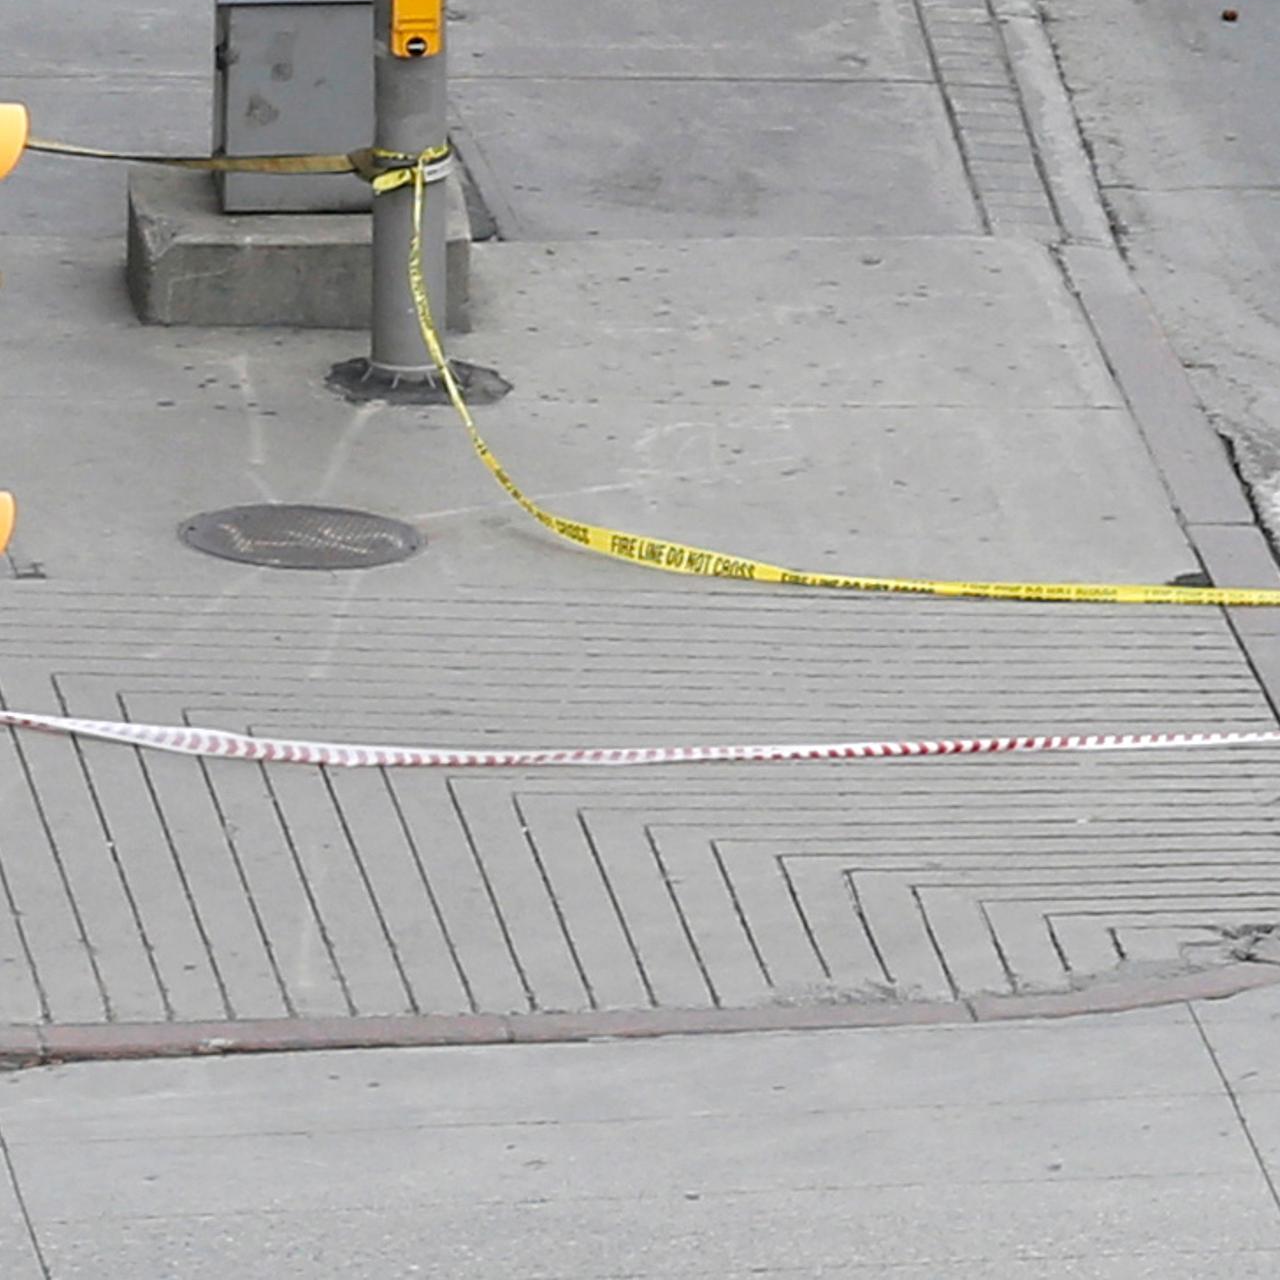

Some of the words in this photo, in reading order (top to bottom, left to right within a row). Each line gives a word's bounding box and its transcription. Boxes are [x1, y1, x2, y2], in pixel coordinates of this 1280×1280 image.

[610, 534, 637, 559] FIRE
[638, 541, 664, 565] LINE
[666, 546, 684, 569] DO
[686, 550, 712, 573] NOT
